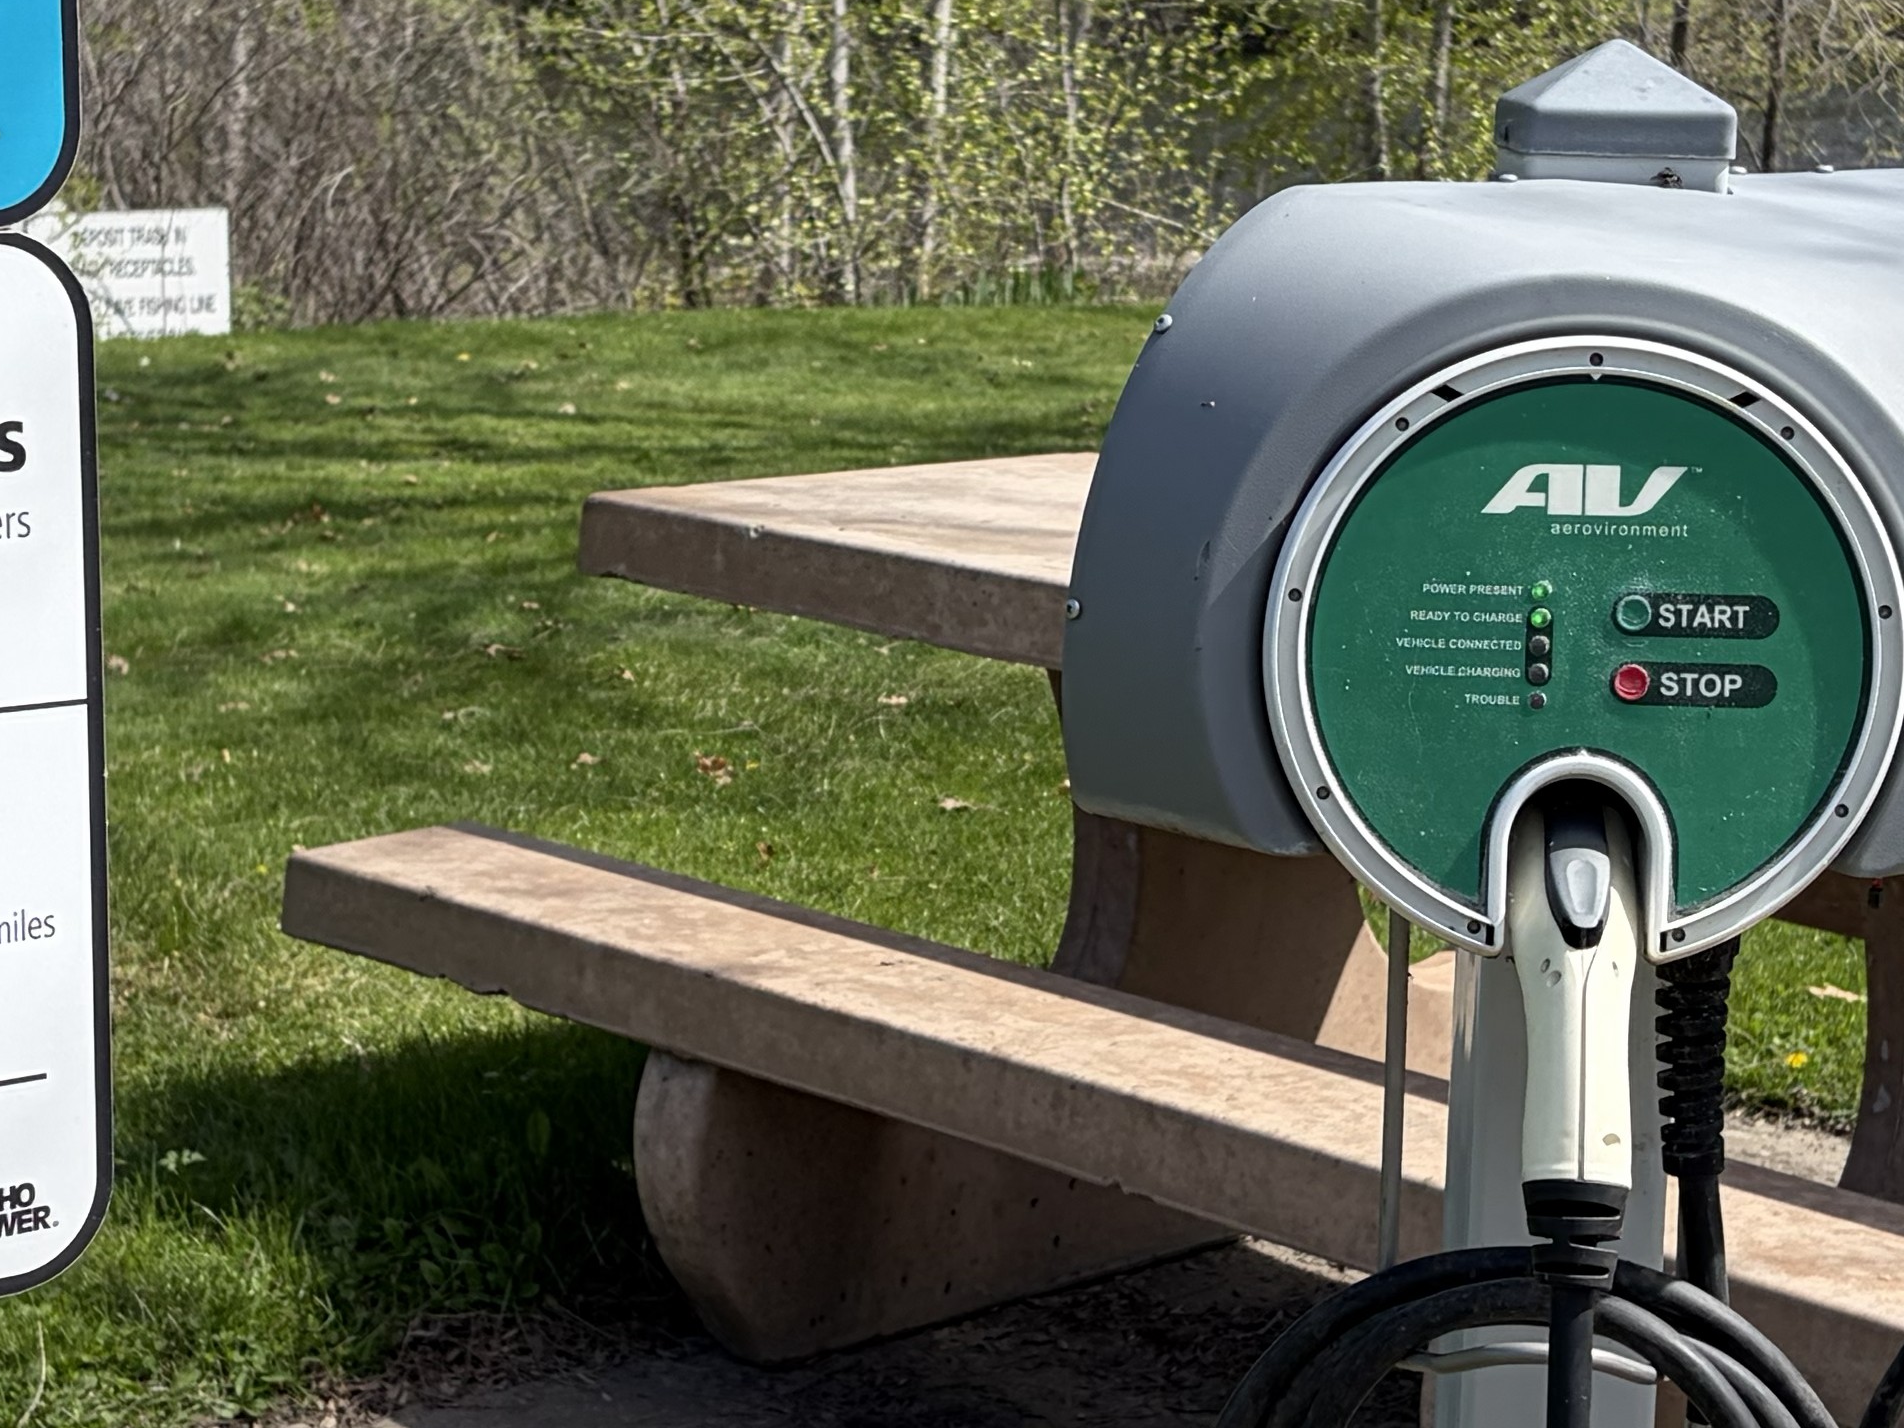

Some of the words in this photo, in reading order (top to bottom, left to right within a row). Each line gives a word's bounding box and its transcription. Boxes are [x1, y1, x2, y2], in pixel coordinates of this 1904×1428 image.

[1482, 464, 1687, 516] AV
[1551, 522, 1687, 537] aerovironment
[1423, 583, 1466, 594] POWER
[1470, 585, 1523, 595] PRESENT
[1410, 610, 1450, 620] READY
[1454, 612, 1470, 622] TO
[1473, 612, 1522, 623] CHARGE
[1659, 604, 1749, 628] START
[1396, 638, 1446, 648] VEHICLE
[1449, 639, 1522, 650] CONNECTED
[1405, 665, 1456, 676] VEHICLE
[1457, 667, 1520, 677] CHARGING
[1660, 672, 1742, 697] STOP
[1465, 694, 1519, 705] TROUBLE
